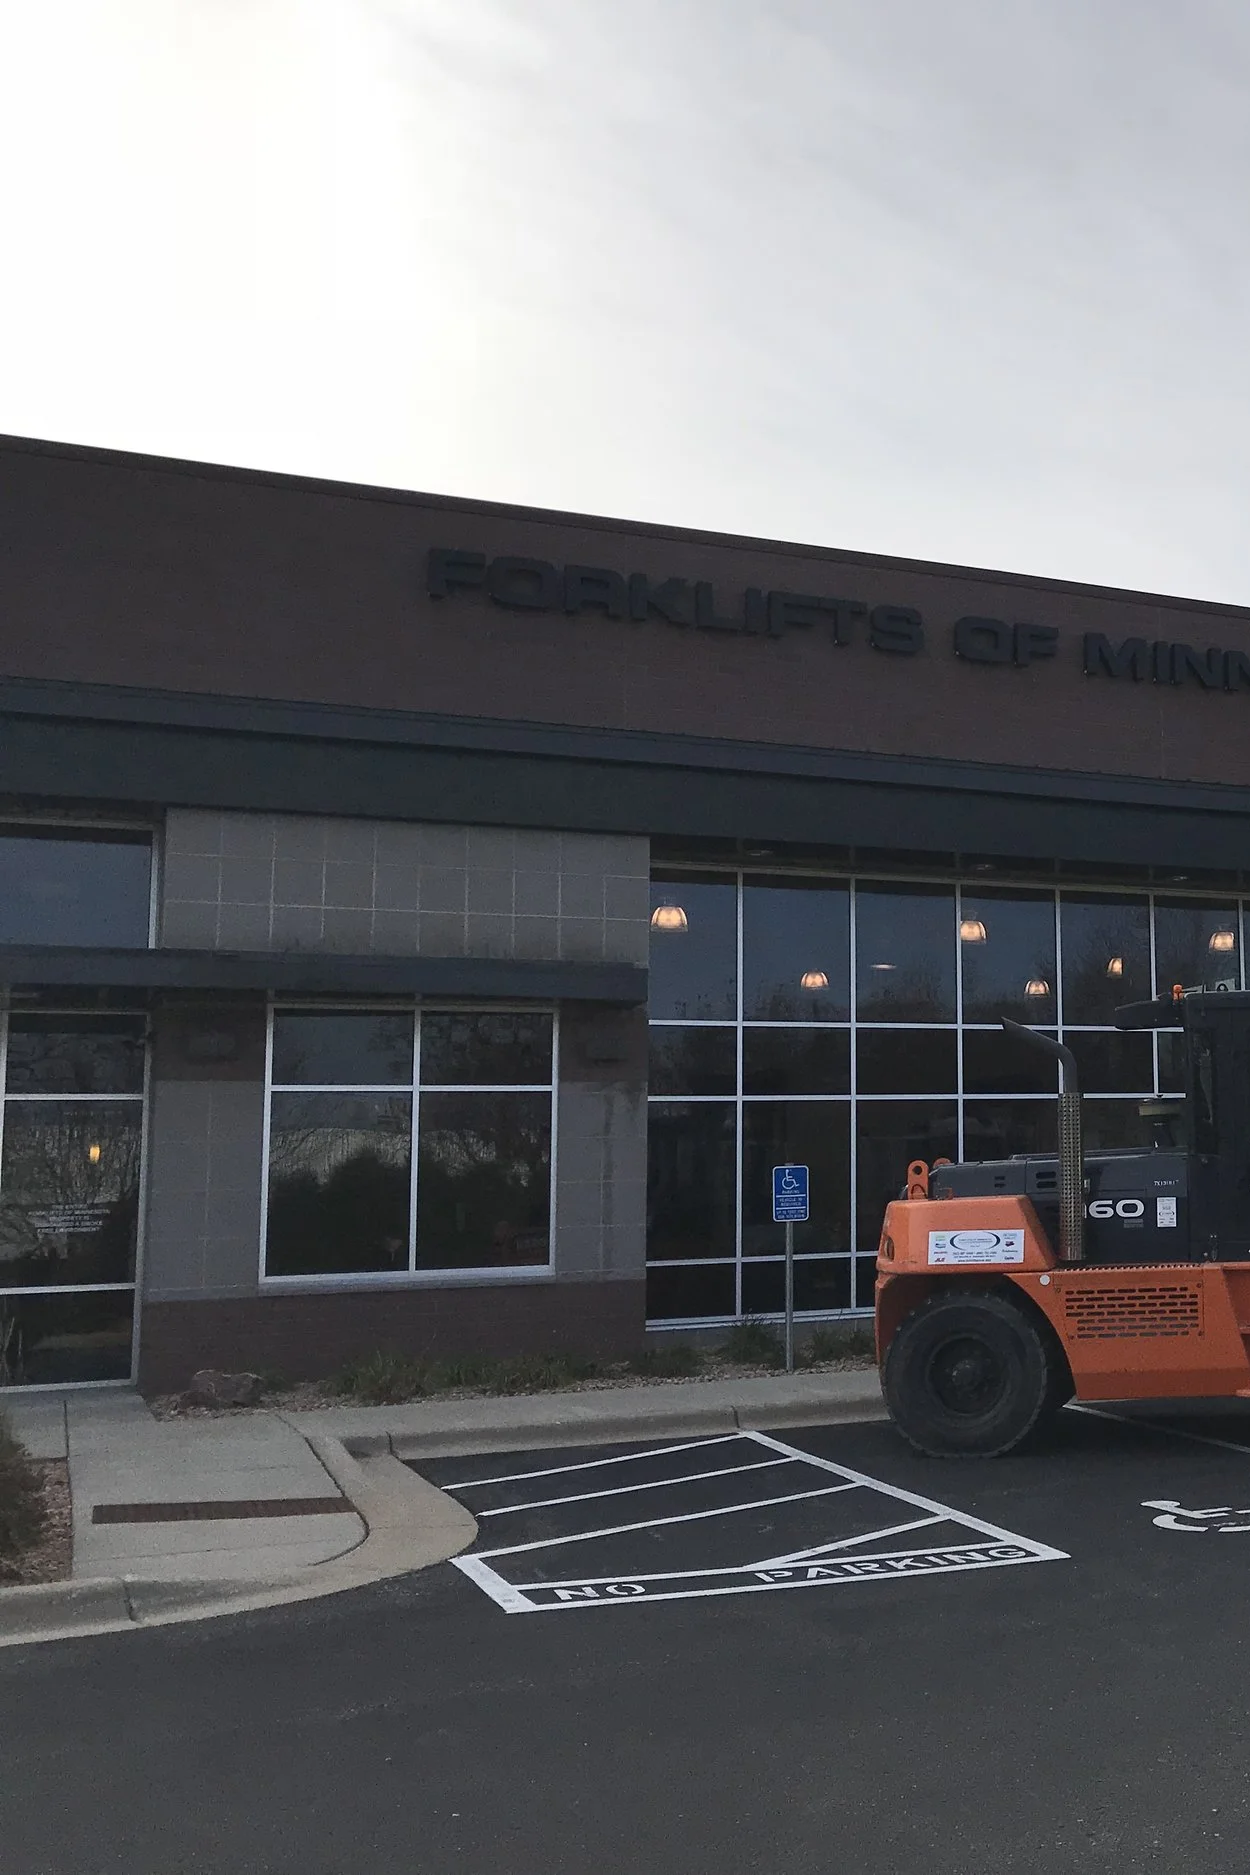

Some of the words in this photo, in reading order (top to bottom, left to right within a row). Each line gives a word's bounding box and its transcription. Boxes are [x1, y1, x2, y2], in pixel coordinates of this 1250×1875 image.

[428, 548, 923, 656] FORKLIFTS
[953, 614, 1060, 667] OF
[554, 1580, 646, 1602] NO
[755, 1544, 1029, 1583] PARKING
